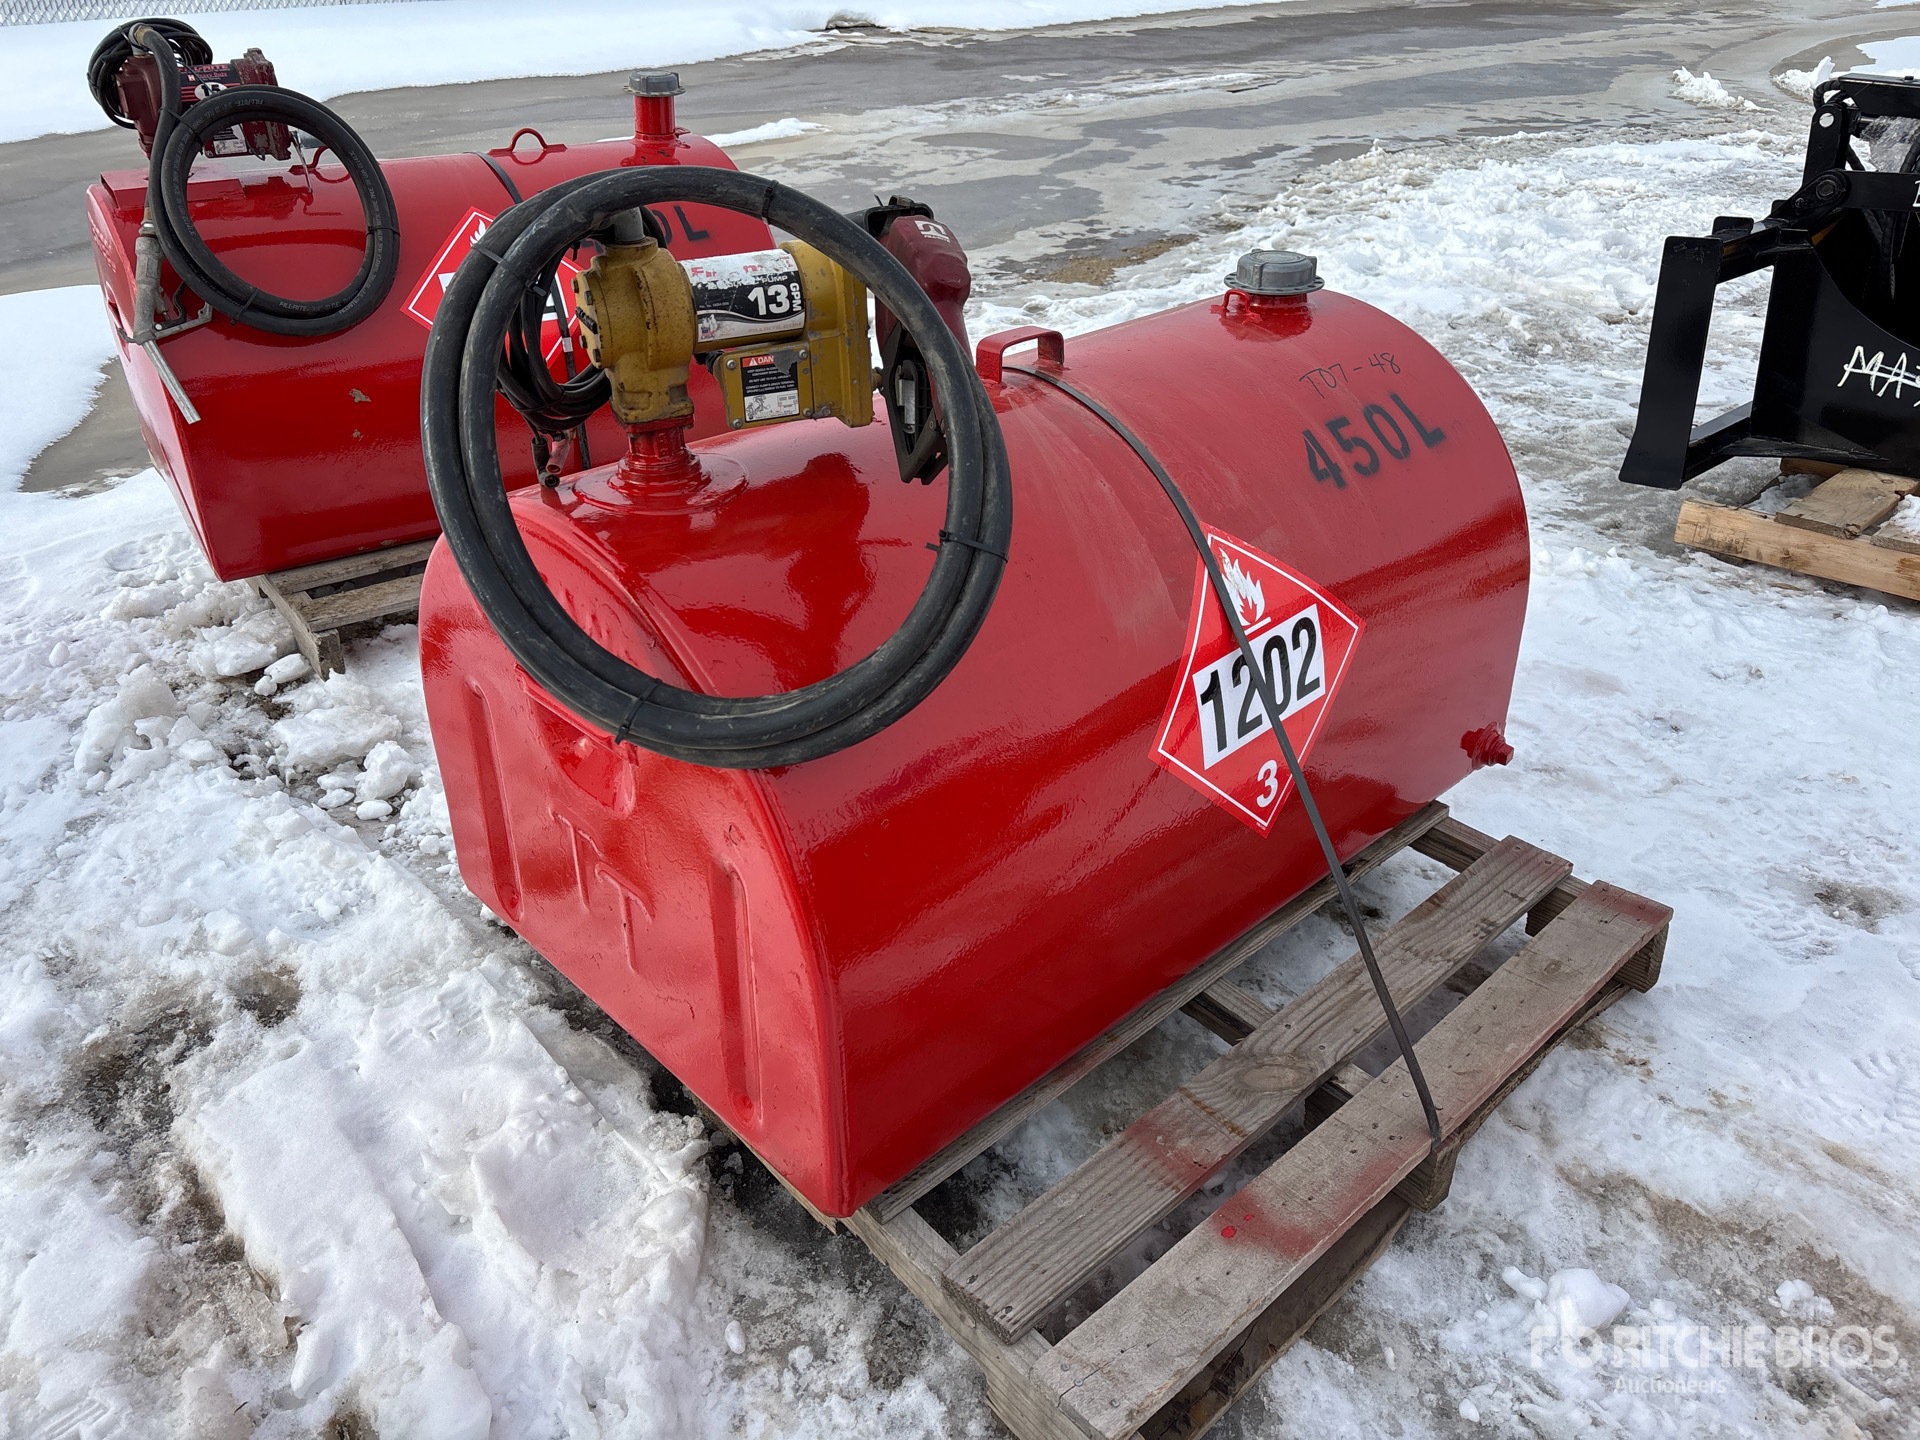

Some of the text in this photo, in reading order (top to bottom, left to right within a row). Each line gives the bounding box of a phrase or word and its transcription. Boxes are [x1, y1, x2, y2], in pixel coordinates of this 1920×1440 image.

[748, 284, 790, 315] 13
[789, 282, 802, 312] GPM
[1302, 392, 1446, 489] 450L
[1200, 616, 1322, 753] 1202
[1256, 759, 1279, 808] 3
